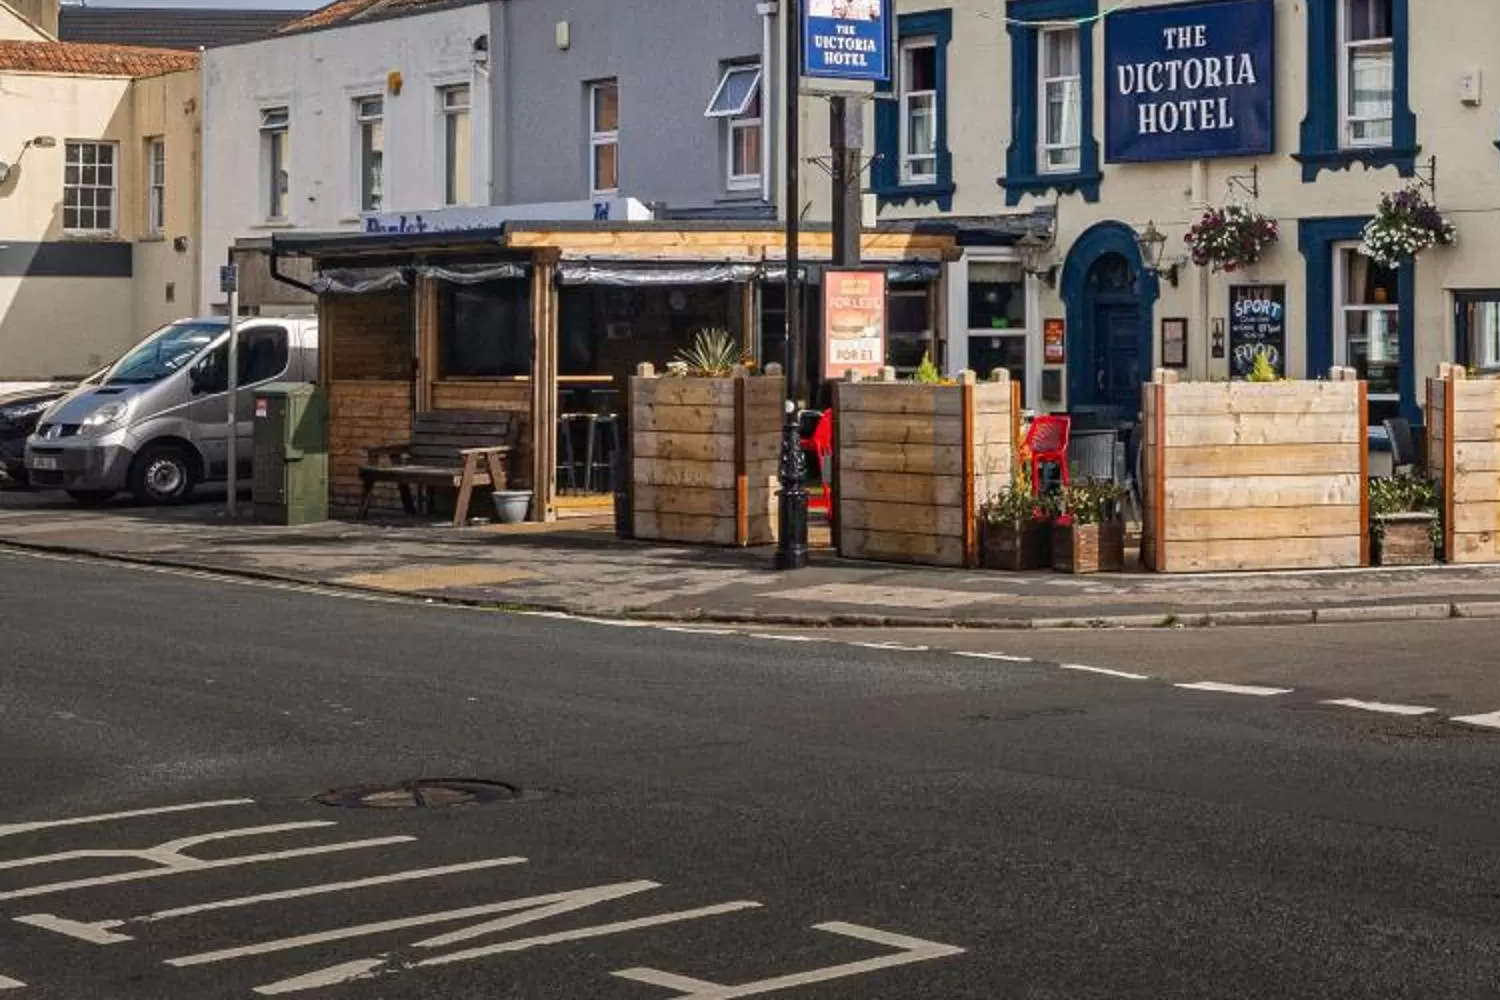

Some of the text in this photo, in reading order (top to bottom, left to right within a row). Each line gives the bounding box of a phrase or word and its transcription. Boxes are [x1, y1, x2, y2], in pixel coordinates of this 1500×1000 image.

[835, 25, 856, 35] THE
[1163, 24, 1207, 50] THE
[815, 36, 877, 53] VICTORIA
[824, 51, 868, 67] HOTEL
[1117, 53, 1256, 95] VICTORIA
[1138, 97, 1234, 134] HOTEL
[1234, 299, 1281, 317] SPORT
